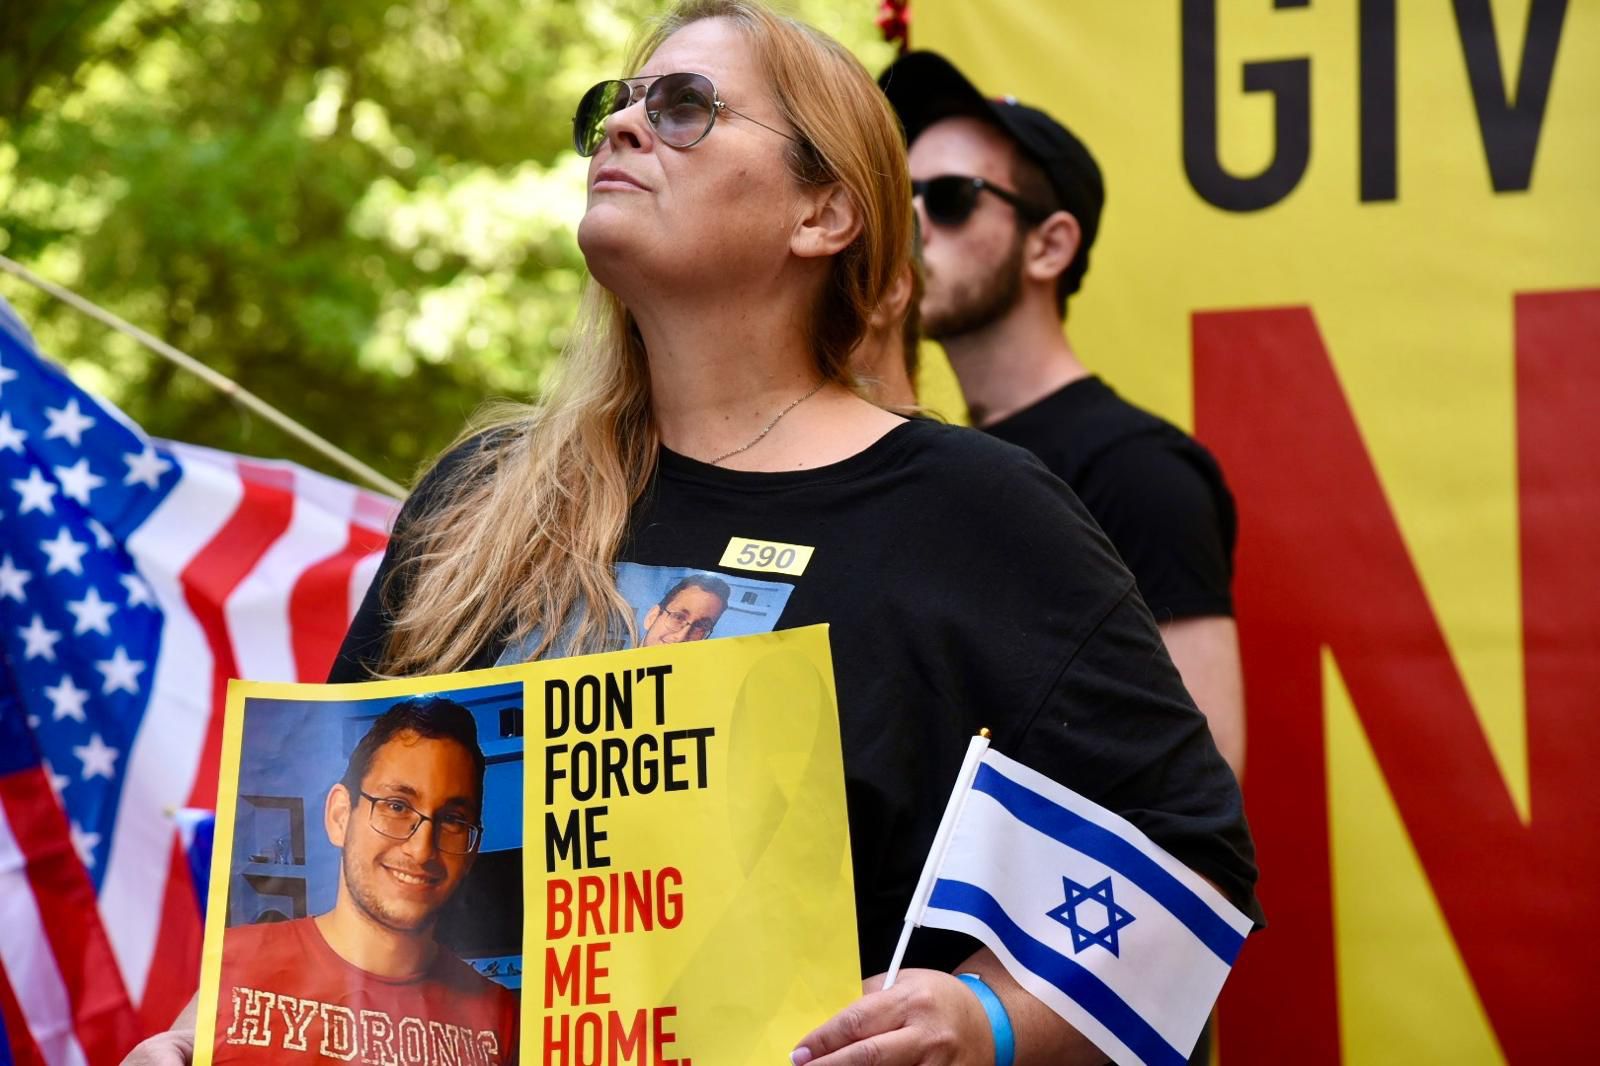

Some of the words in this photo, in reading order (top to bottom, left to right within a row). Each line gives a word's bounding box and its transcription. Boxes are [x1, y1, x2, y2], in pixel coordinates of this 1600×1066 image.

[1181, 0, 1569, 213] GIV
[736, 543, 796, 569] 590
[545, 665, 673, 739] DON'T
[545, 727, 715, 805] FORGET
[545, 806, 611, 872] ME
[546, 867, 684, 940] BRING
[544, 942, 611, 1008] ME
[543, 1006, 692, 1066] HOME.
